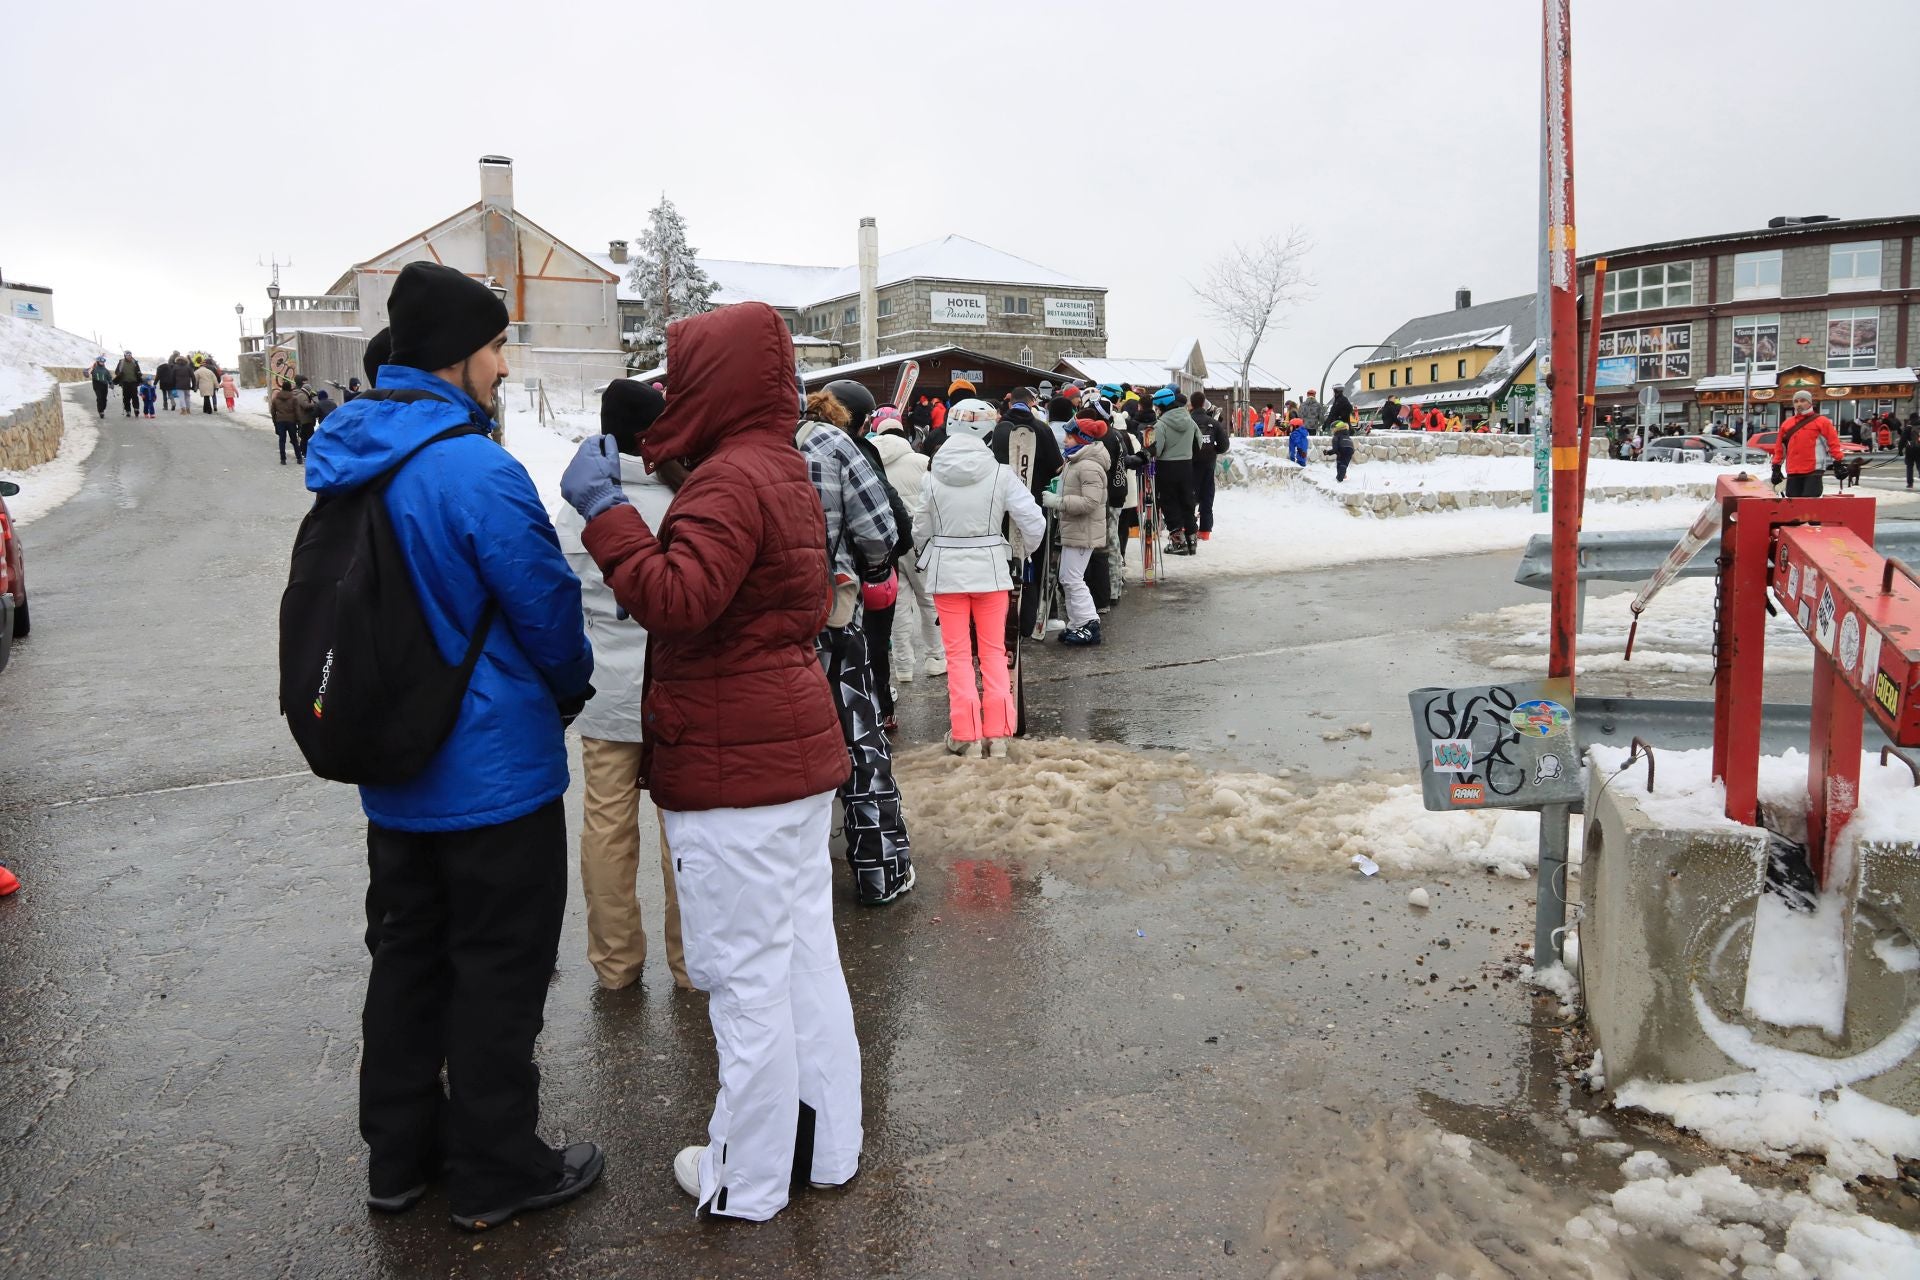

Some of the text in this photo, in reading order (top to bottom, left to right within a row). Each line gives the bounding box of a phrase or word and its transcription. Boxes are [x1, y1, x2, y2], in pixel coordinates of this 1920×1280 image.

[947, 298, 981, 308] HOTEL
[1599, 330, 1689, 351] RESTAURANTE
[953, 372, 981, 380] TAQUILLAS
[318, 648, 334, 694] DocPath
[1876, 672, 1899, 717] GÜERA
